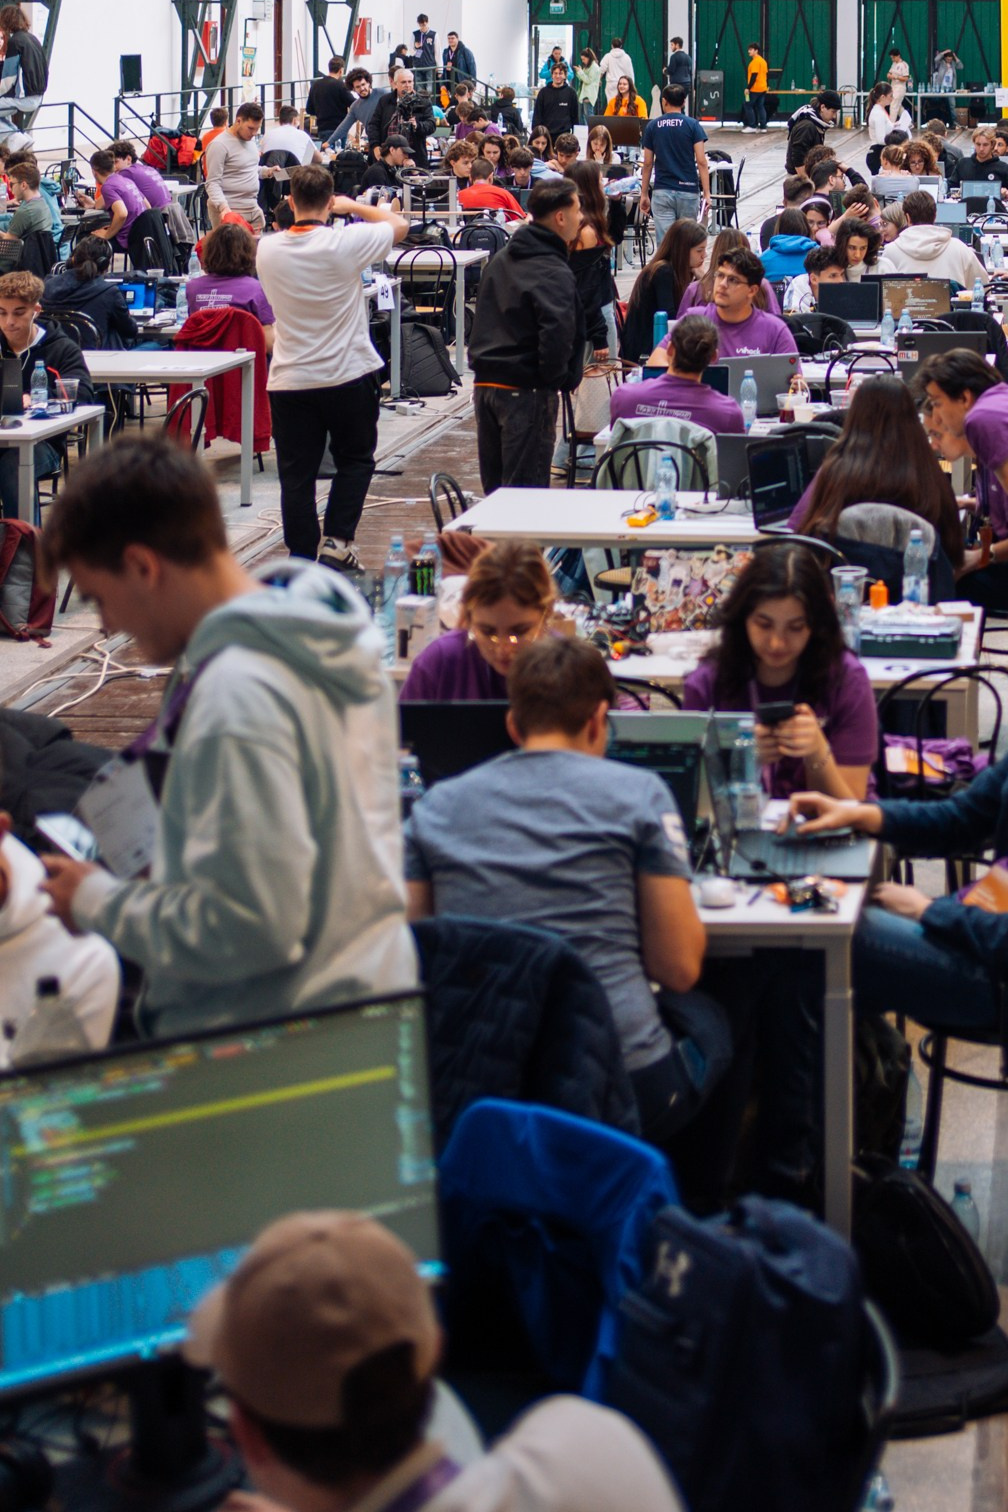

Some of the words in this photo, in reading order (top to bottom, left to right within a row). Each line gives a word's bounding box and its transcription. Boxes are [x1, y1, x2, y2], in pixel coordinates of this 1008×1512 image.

[657, 119, 684, 128] UPRETY
[381, 284, 389, 299] 49
[898, 351, 918, 360] MLH
